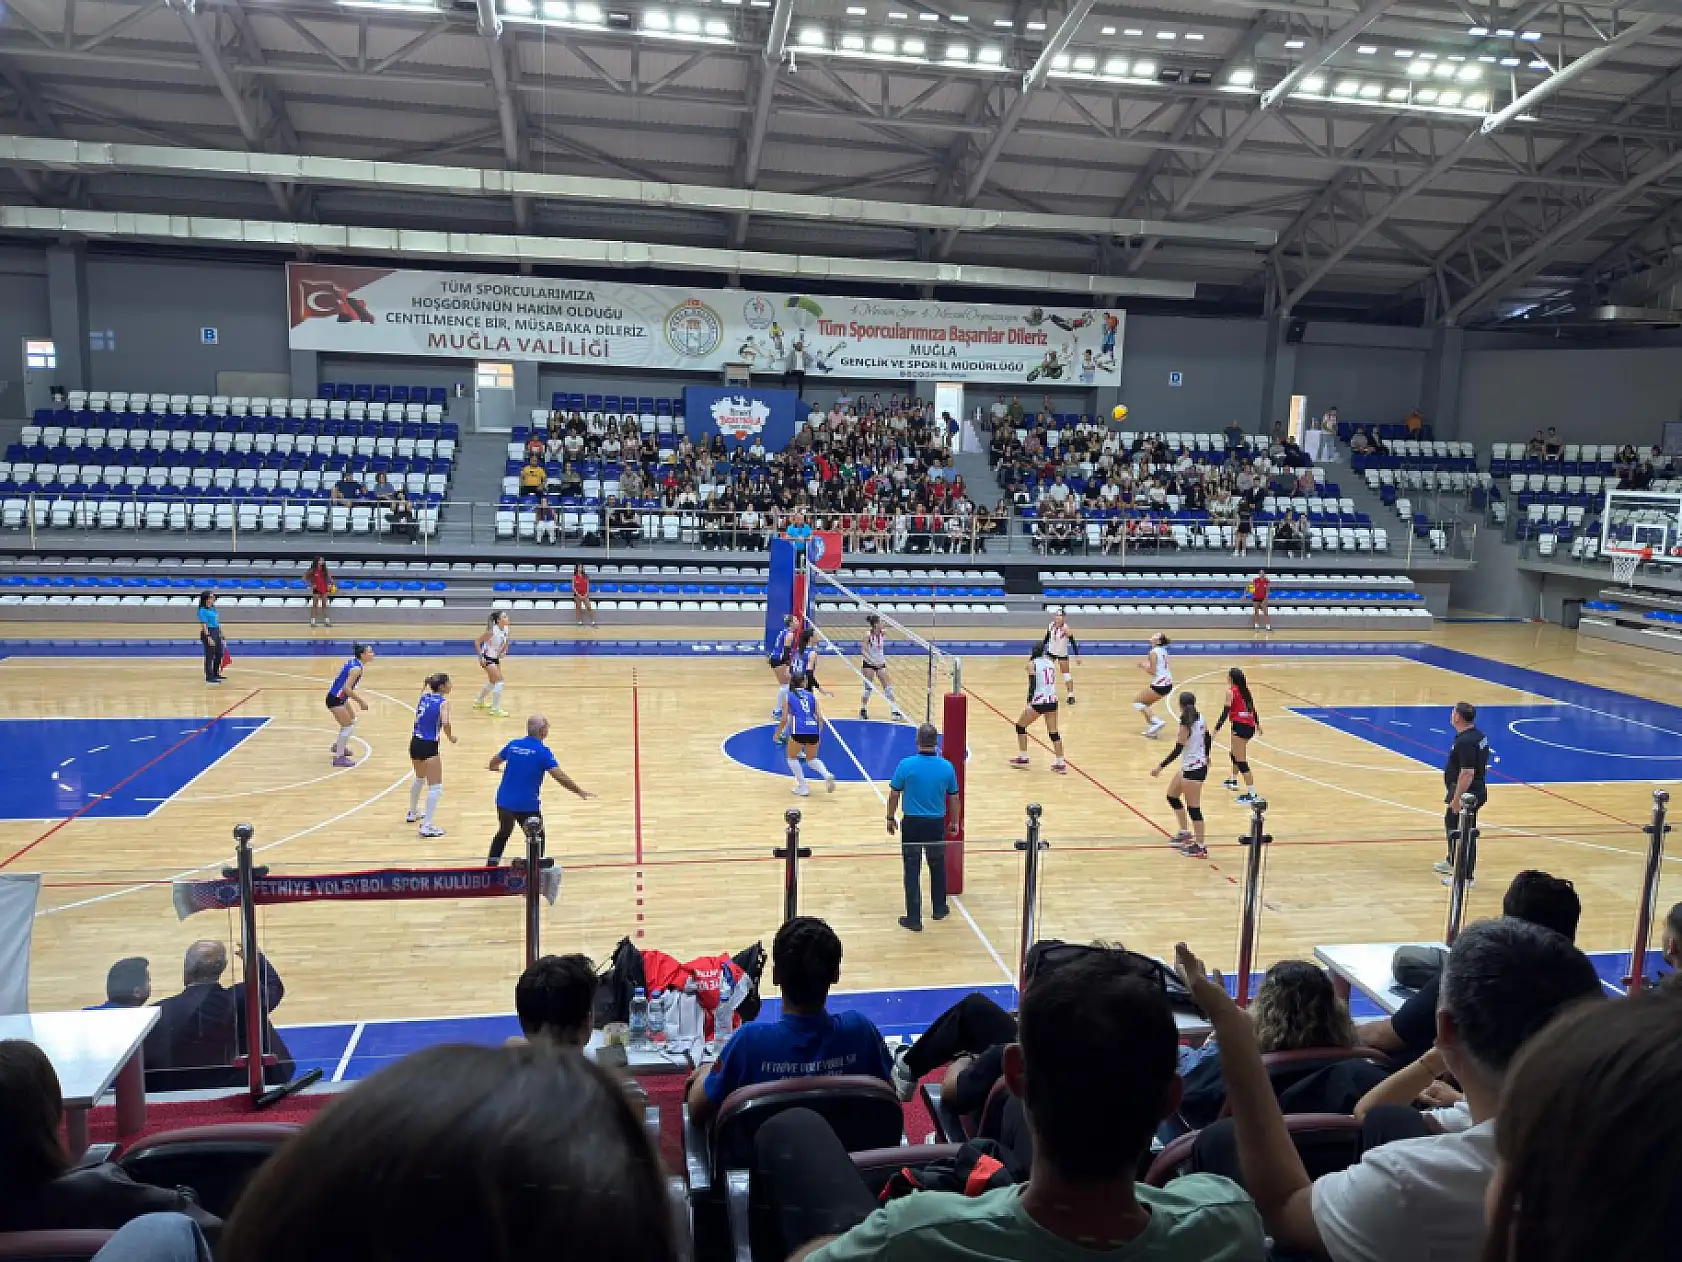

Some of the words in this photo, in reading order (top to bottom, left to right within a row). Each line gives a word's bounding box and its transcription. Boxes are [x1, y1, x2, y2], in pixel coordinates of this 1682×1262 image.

[440, 280, 472, 294] TÜM
[476, 283, 596, 302] SPORCULARIMIZA
[411, 296, 512, 313] HOŞGÖRÜNÜN
[516, 301, 562, 316] HAKİM
[566, 306, 623, 320] OLDUĞU
[514, 318, 592, 334] MÜSABAKA
[816, 319, 847, 337] Tüm
[849, 321, 946, 343] Sporcularımıza
[949, 325, 1005, 348] Başarılar
[1007, 327, 1048, 346] Dileriz
[428, 330, 512, 352] MUĞLA
[516, 336, 610, 358] VALİLİĞİ
[908, 342, 958, 358] MUĞLA
[840, 356, 888, 369] GENÇLİK
[890, 358, 906, 369] VE
[906, 360, 938, 370] SPOR
[951, 360, 1024, 372] MÜDÜRLÜĞÜ
[252, 880, 312, 897] FETHİYE
[315, 877, 389, 895] VOLEYBOL
[391, 876, 430, 892] SPOR
[432, 872, 491, 891] KULÜBÜ
